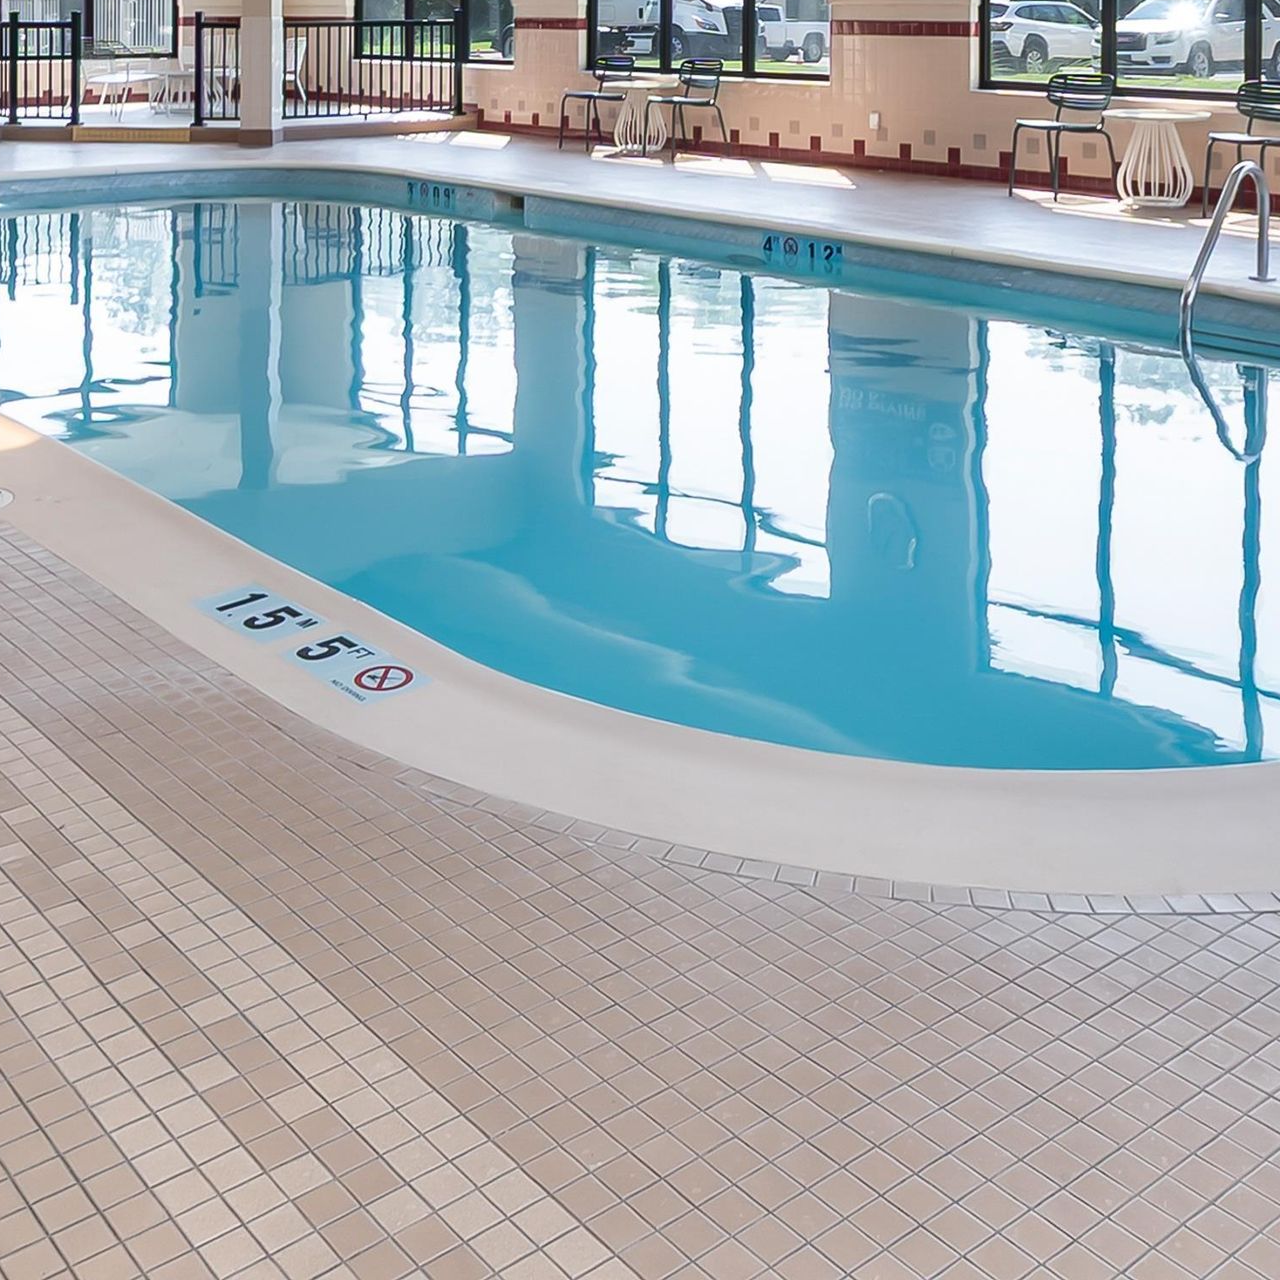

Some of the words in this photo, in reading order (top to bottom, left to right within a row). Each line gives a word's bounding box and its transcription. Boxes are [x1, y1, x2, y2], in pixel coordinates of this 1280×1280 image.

[763, 236, 773, 251] 4
[296, 636, 359, 661] 5
[347, 647, 375, 659] FT
